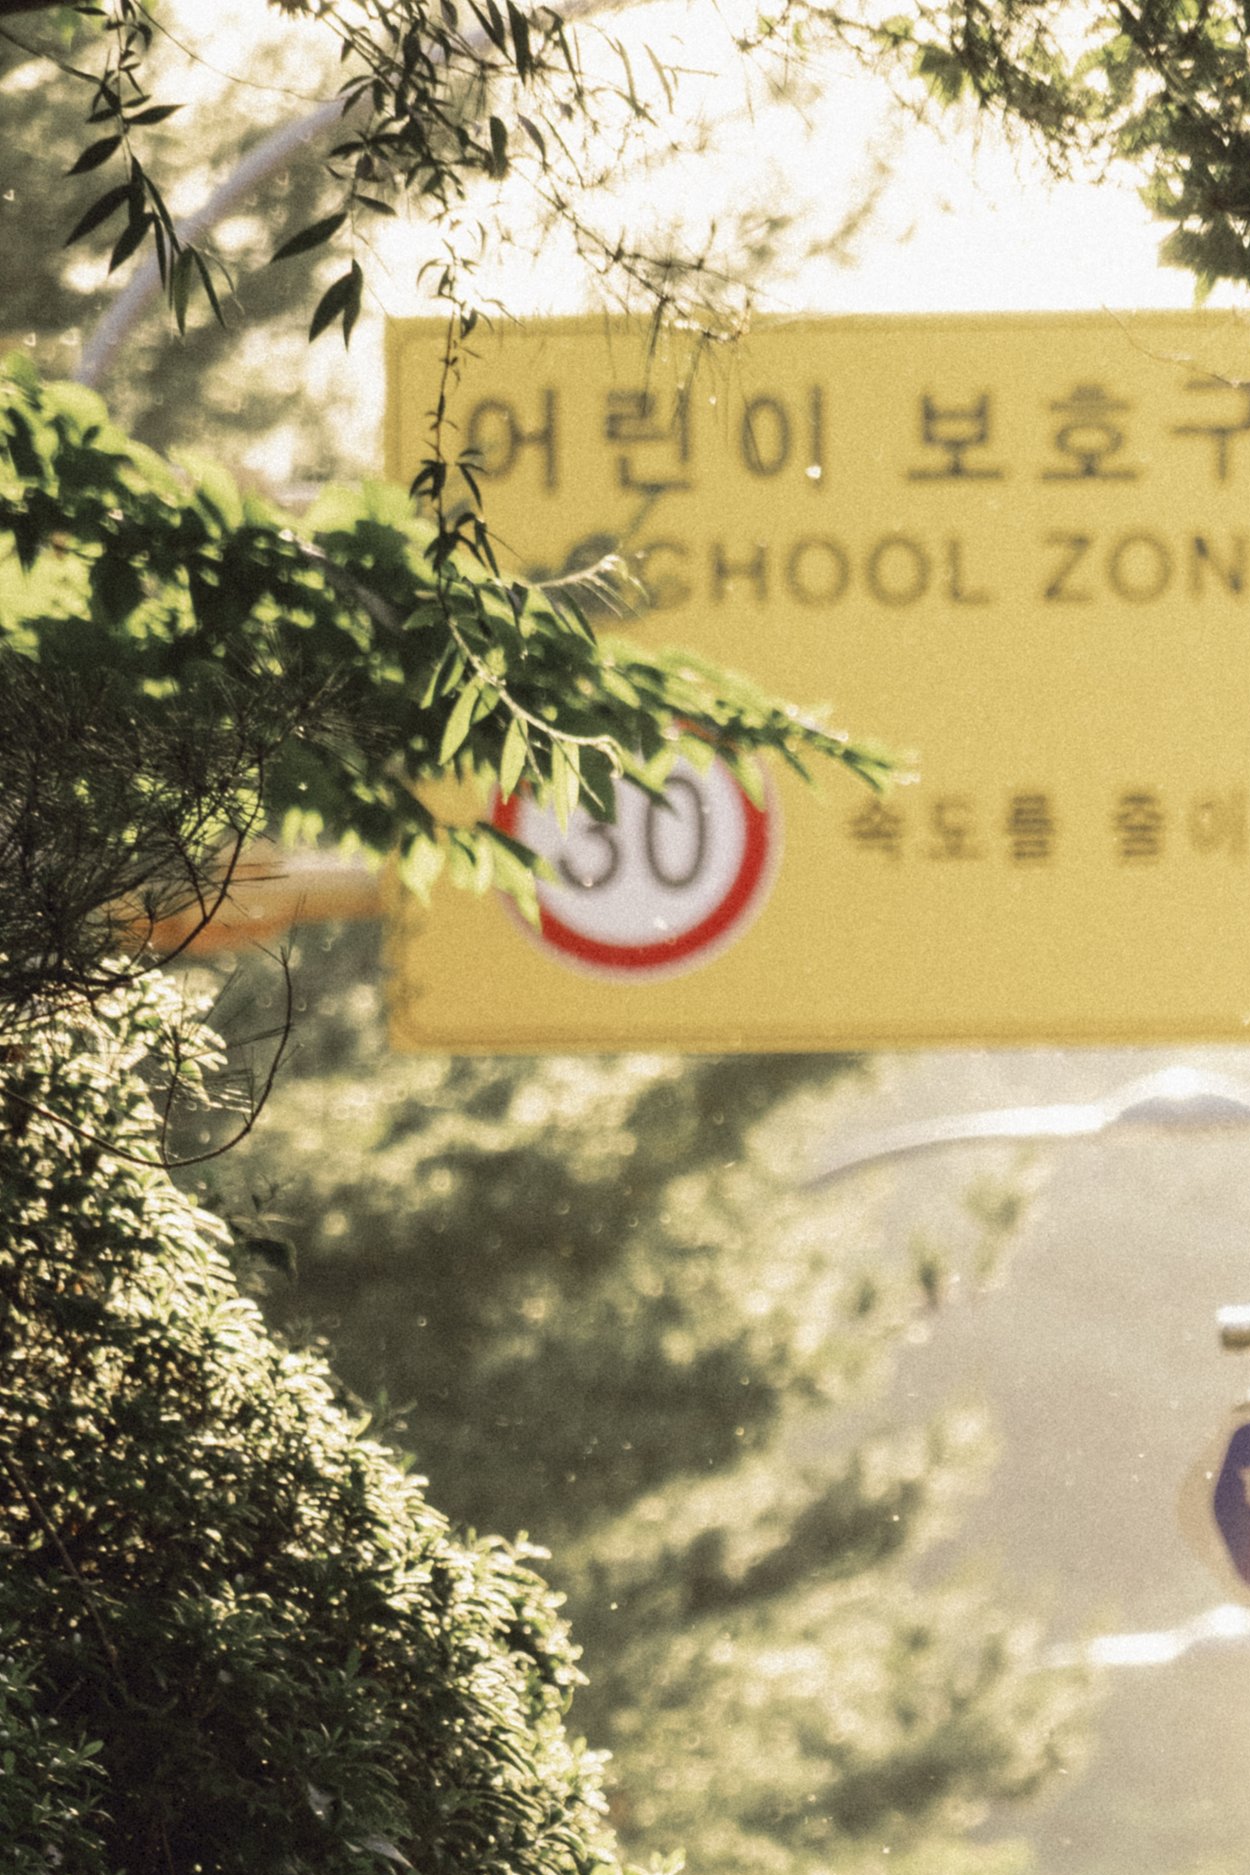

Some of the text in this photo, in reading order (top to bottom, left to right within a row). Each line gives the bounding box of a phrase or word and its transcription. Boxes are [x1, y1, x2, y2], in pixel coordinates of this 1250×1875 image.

[466, 387, 824, 493] 어린이
[582, 532, 991, 610] CHOOL
[559, 777, 706, 888] 30
